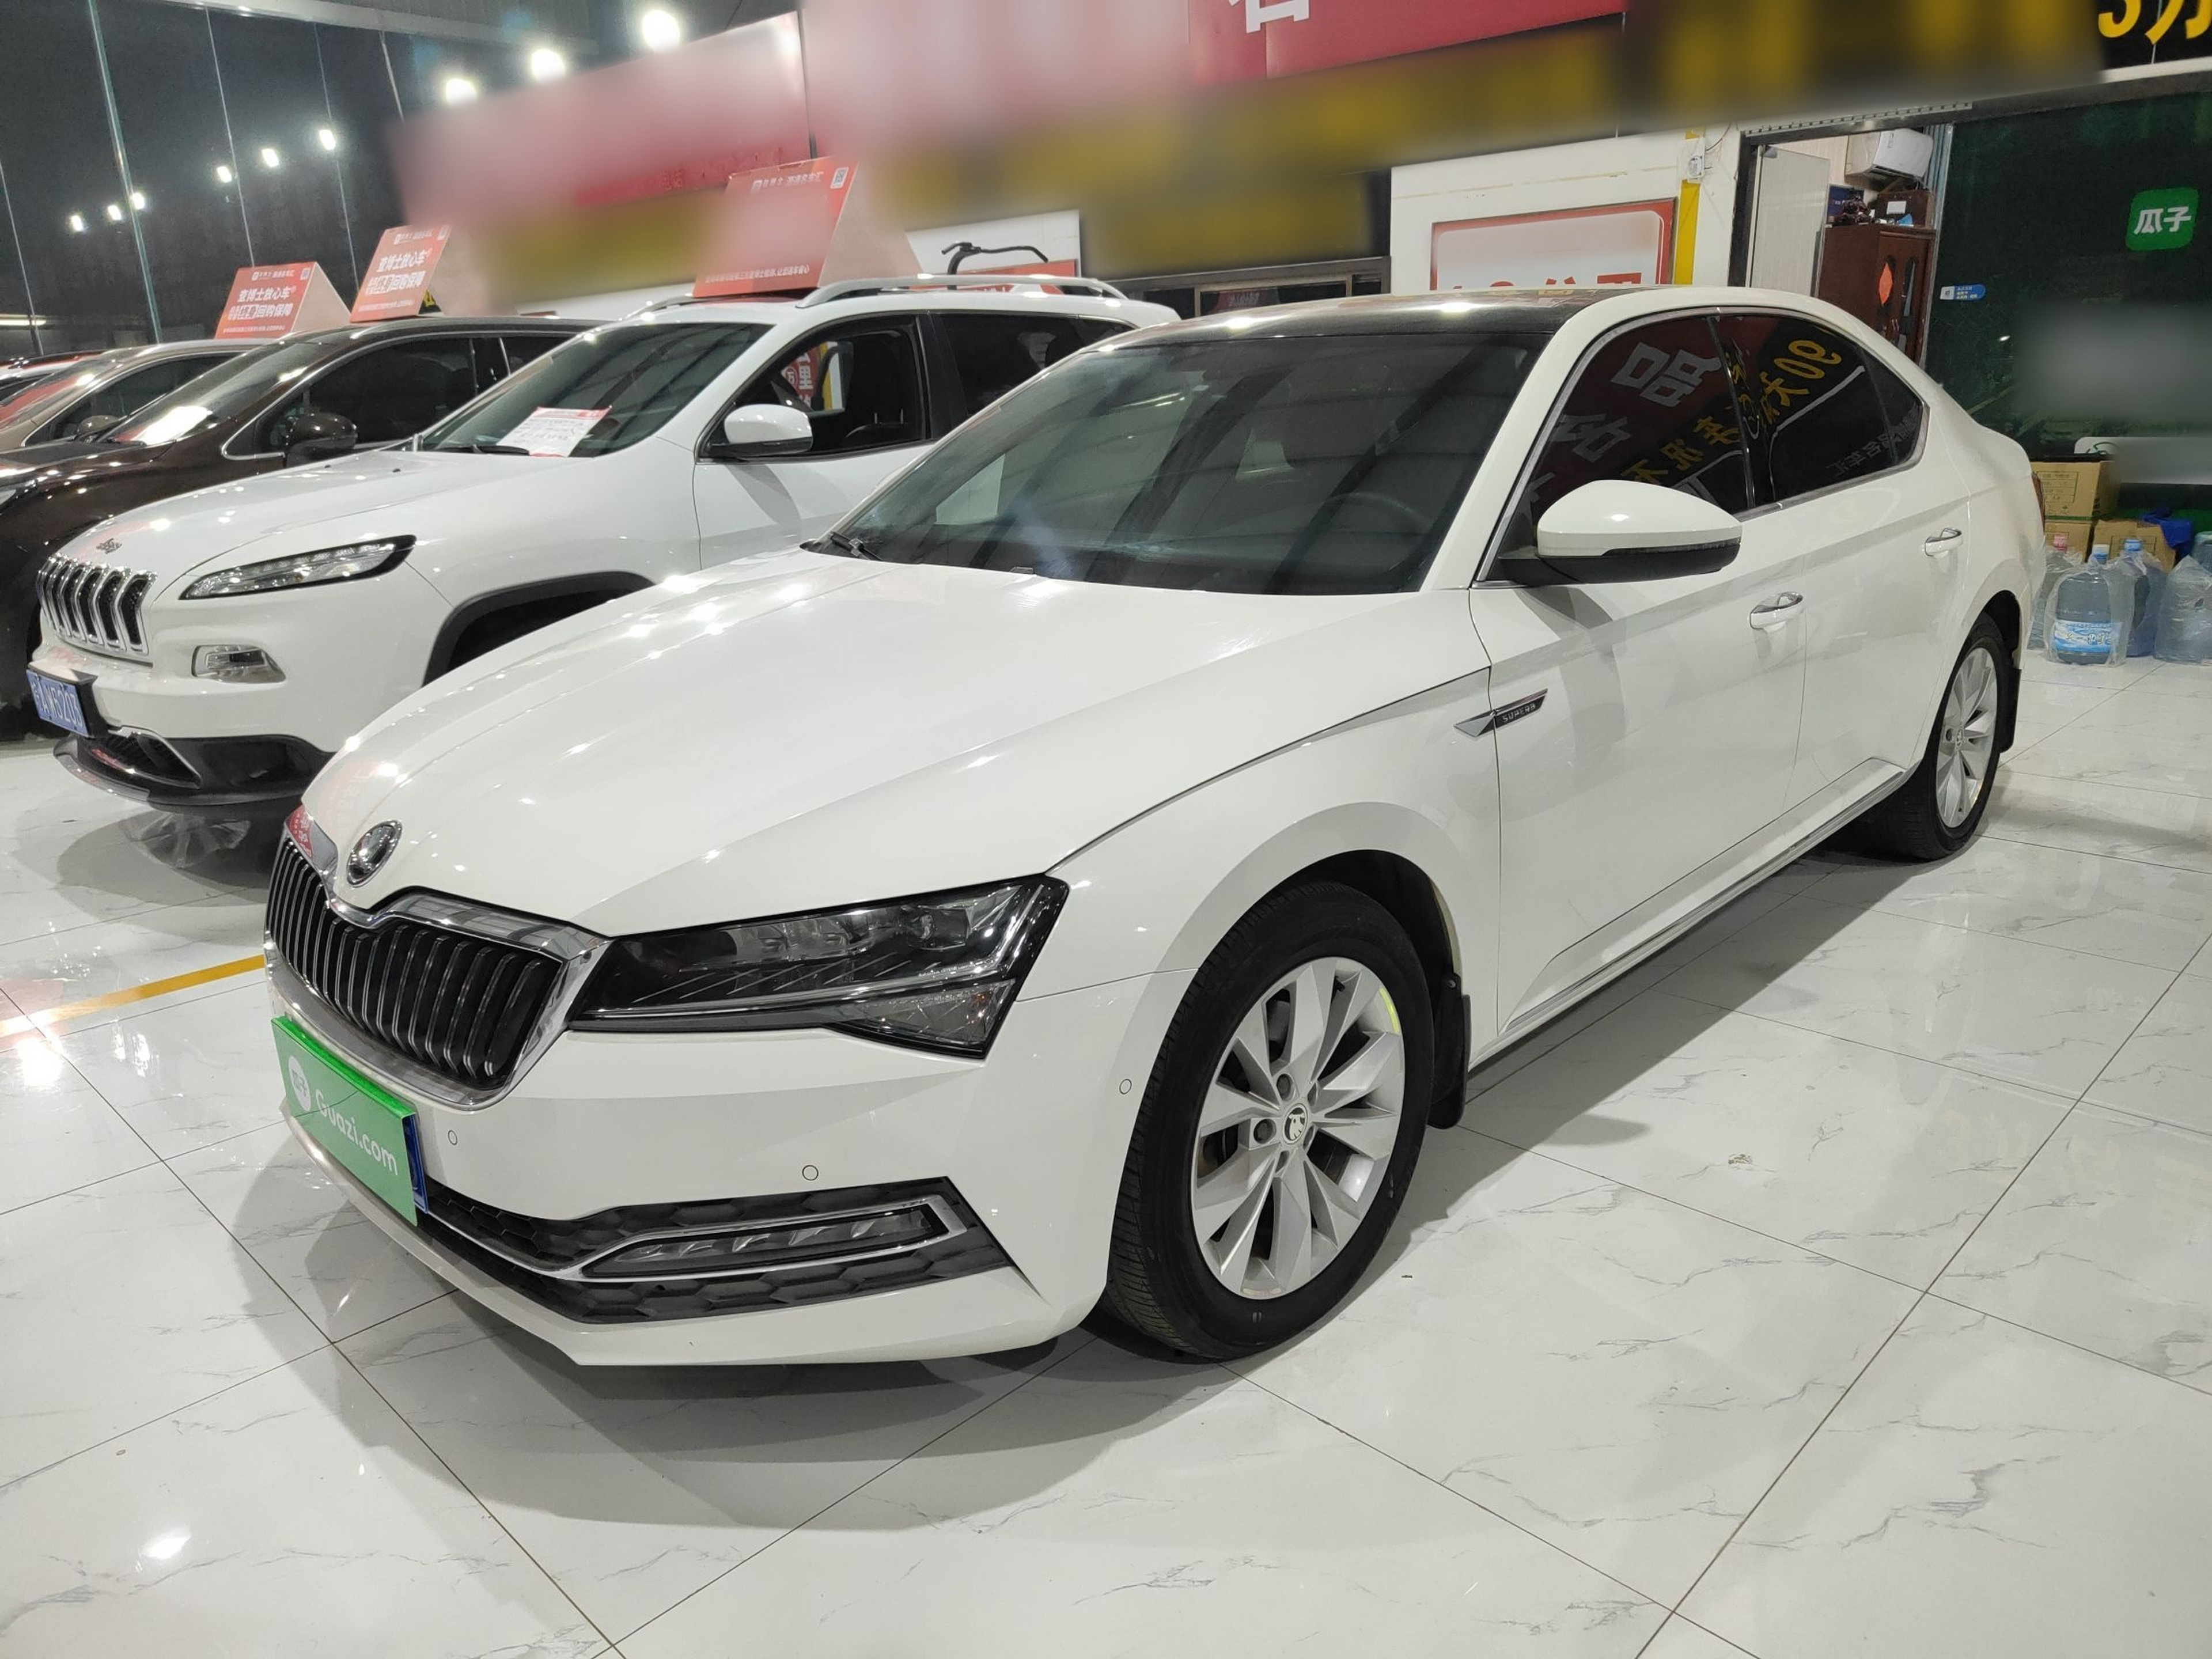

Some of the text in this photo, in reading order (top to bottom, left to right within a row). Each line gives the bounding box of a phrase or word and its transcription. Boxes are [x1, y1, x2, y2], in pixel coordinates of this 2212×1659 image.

[2133, 206, 2191, 234] 瓜子
[237, 286, 291, 302] 查博士放心车
[1502, 703, 1536, 722] SUPERB
[316, 1089, 398, 1175] Guazi.com
